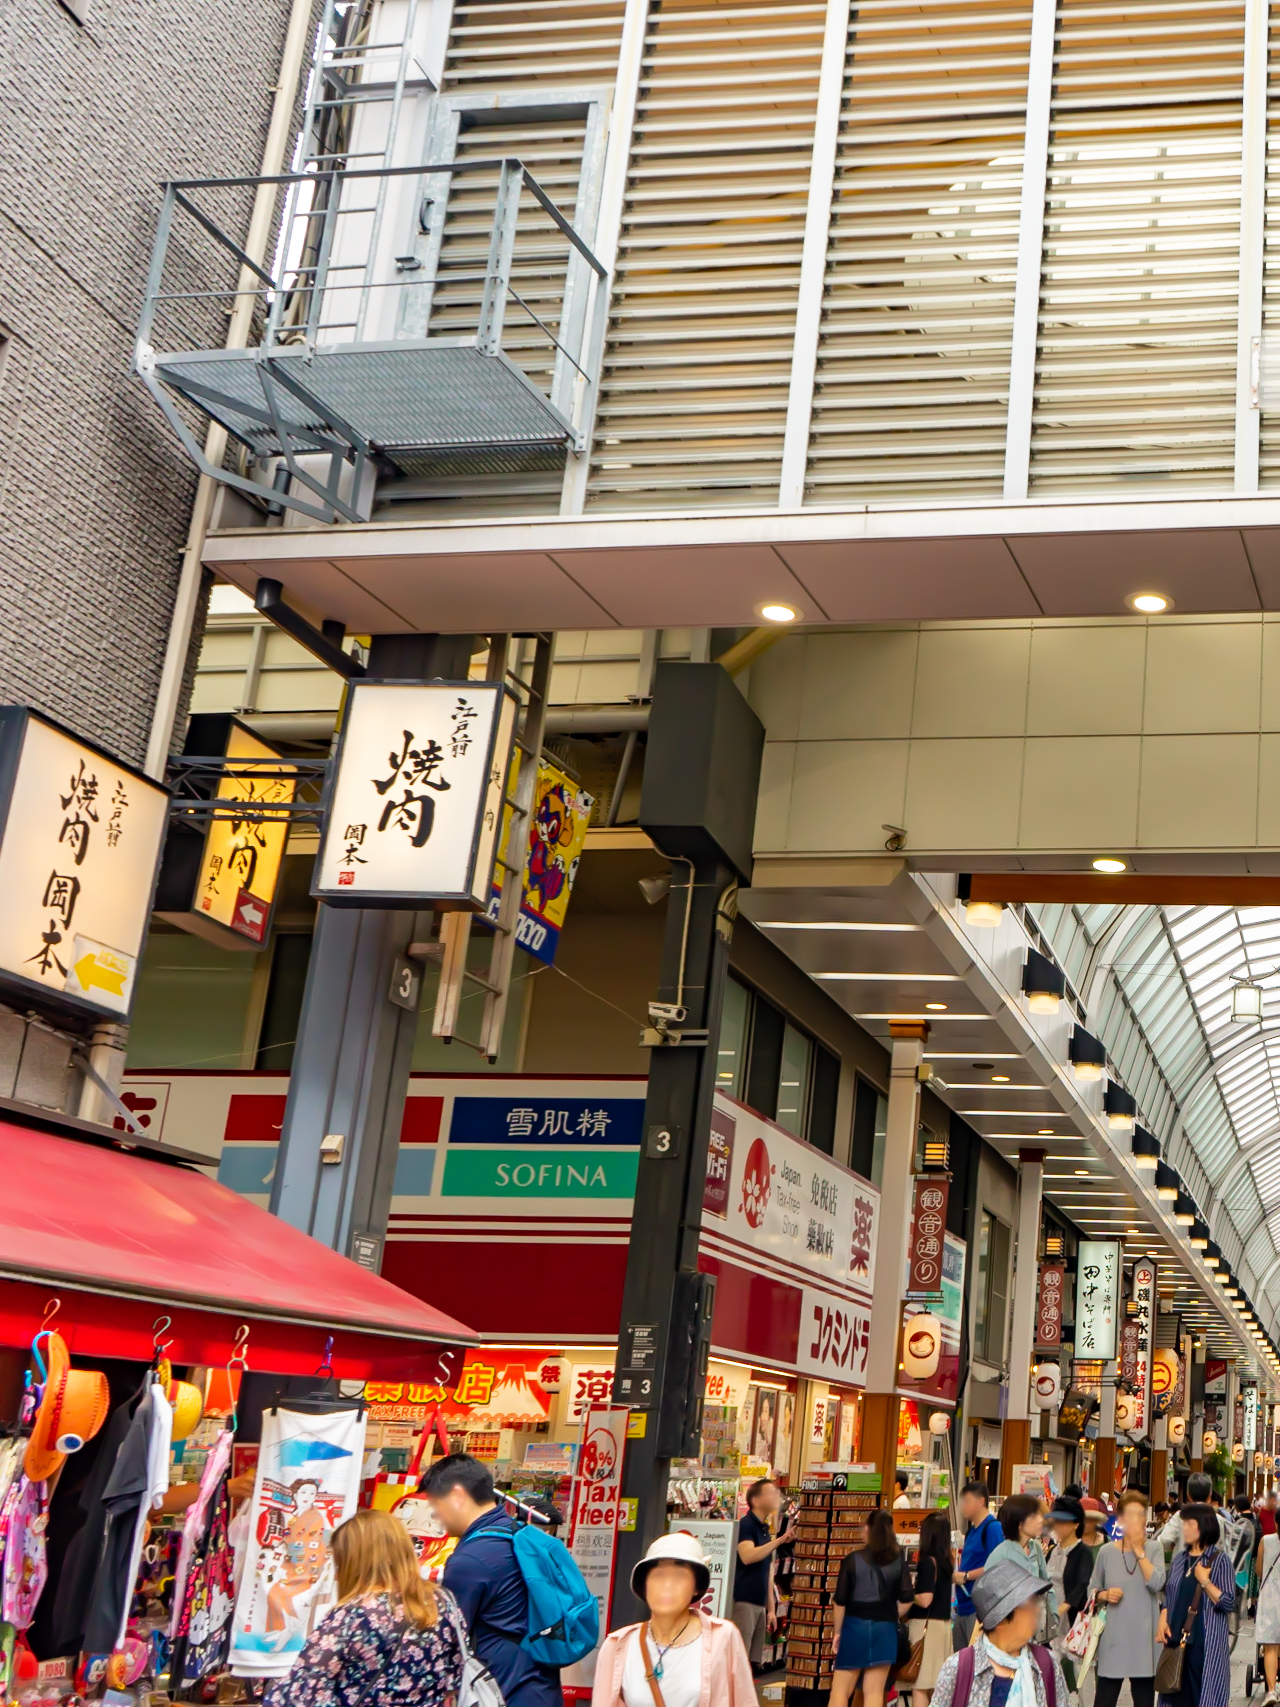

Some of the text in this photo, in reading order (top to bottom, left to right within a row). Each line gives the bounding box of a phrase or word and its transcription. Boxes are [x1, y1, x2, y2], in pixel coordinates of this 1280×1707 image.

[446, 697, 479, 758] 江戸前
[370, 729, 451, 848] 焼肉
[105, 780, 129, 847] 江戸前
[335, 823, 369, 866] 岡本
[399, 967, 412, 998] 3
[506, 1108, 612, 1137] 雪肌精
[656, 1131, 670, 1152] 3
[708, 1129, 727, 1152] REE
[495, 1163, 608, 1187] SOFINA
[809, 1172, 839, 1216] 免税店
[914, 1187, 945, 1284] 観音通り
[1040, 1270, 1062, 1341] 観音通り
[1082, 1265, 1101, 1349] 田中そば店
[541, 1365, 561, 1384] 祭
[641, 1379, 651, 1394] 3
[705, 1374, 724, 1396] ree
[394, 1405, 426, 1419] FREE
[813, 1402, 825, 1438] 薬
[583, 1480, 618, 1502] Tax
[579, 1502, 616, 1525] free
[708, 1548, 726, 1556] Shop
